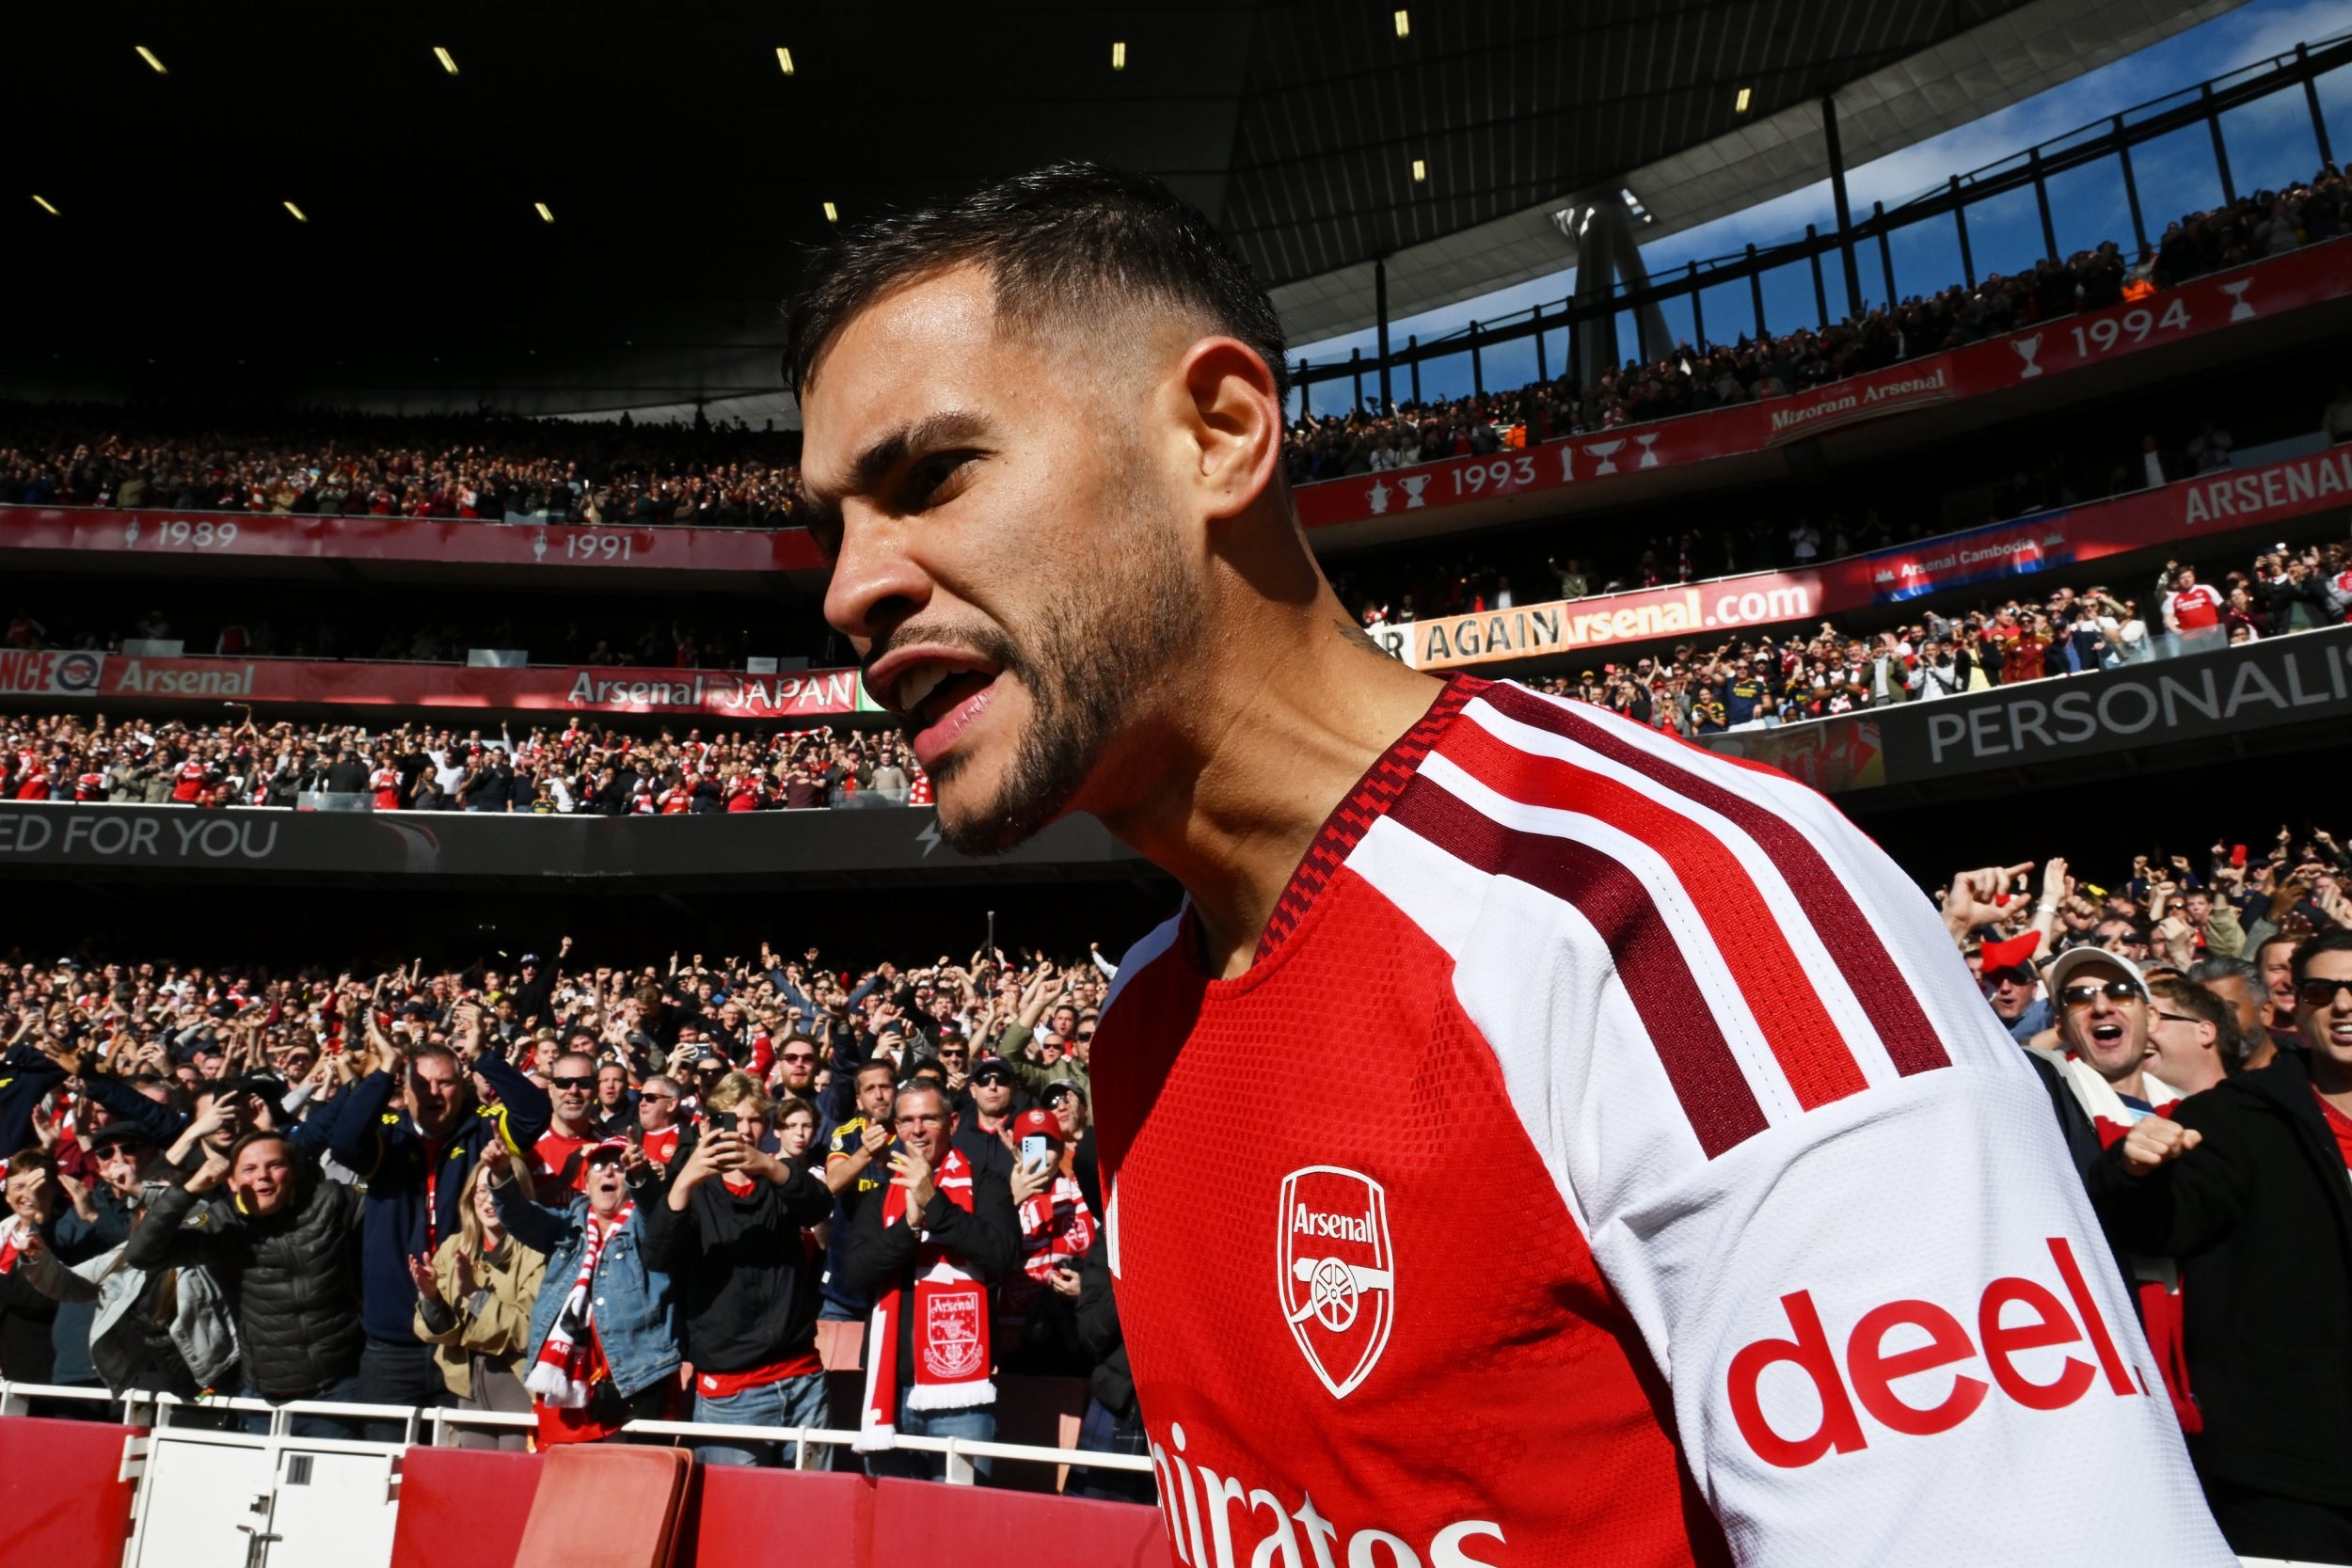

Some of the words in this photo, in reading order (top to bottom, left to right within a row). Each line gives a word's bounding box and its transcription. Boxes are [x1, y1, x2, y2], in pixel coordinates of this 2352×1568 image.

[2071, 298, 2192, 358] 1994
[1771, 394, 1857, 431] Mizoram
[1862, 368, 1946, 404] Arsenal
[1453, 456, 1536, 496] 1993
[158, 521, 238, 547] 1989
[566, 534, 632, 560] 1991
[1900, 555, 1956, 578] Arsenal
[1960, 538, 2036, 563] Cambodia
[1425, 609, 1560, 661] AGAIN
[0, 651, 56, 691] NCE
[115, 661, 255, 694] Arsenal
[567, 671, 703, 705] Arsenal
[724, 672, 852, 709] JAPAN
[1928, 645, 2352, 764] PERSONALI
[62, 816, 160, 855] FOR
[172, 818, 278, 858] YOU
[1293, 1203, 1374, 1243] Arsenal
[931, 1295, 976, 1314] Arsenal
